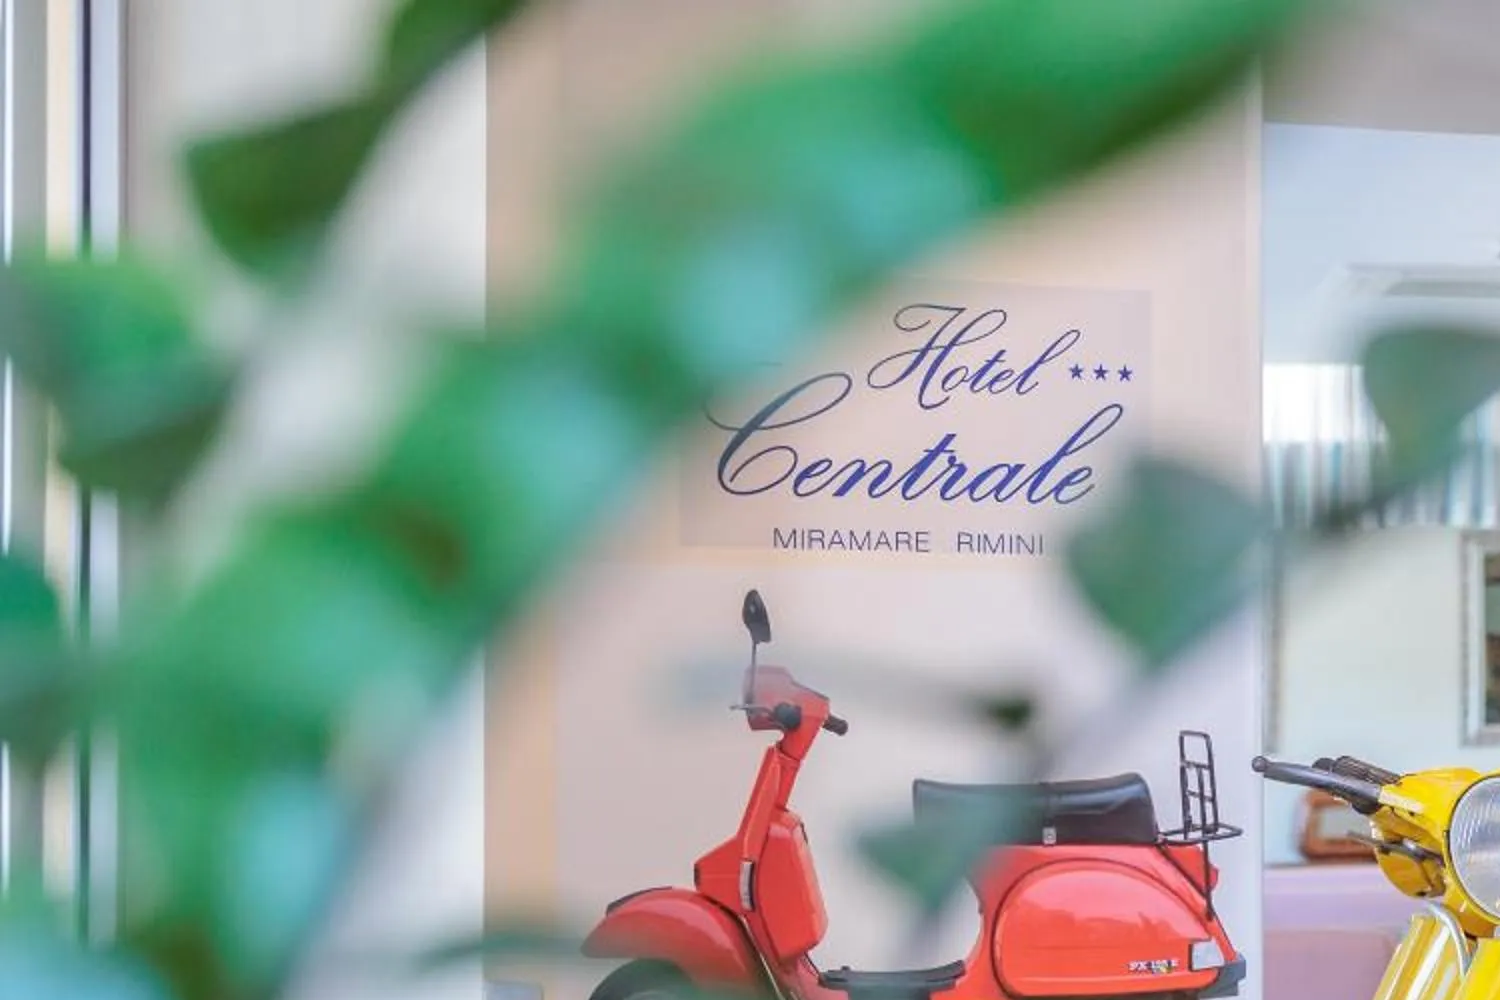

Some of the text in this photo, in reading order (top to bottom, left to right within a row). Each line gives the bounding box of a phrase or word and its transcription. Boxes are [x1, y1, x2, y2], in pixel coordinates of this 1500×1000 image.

[868, 304, 1081, 409] Hotel
[705, 373, 1123, 505] Centrale
[773, 527, 1044, 556] MIRAMARE RIMINI
